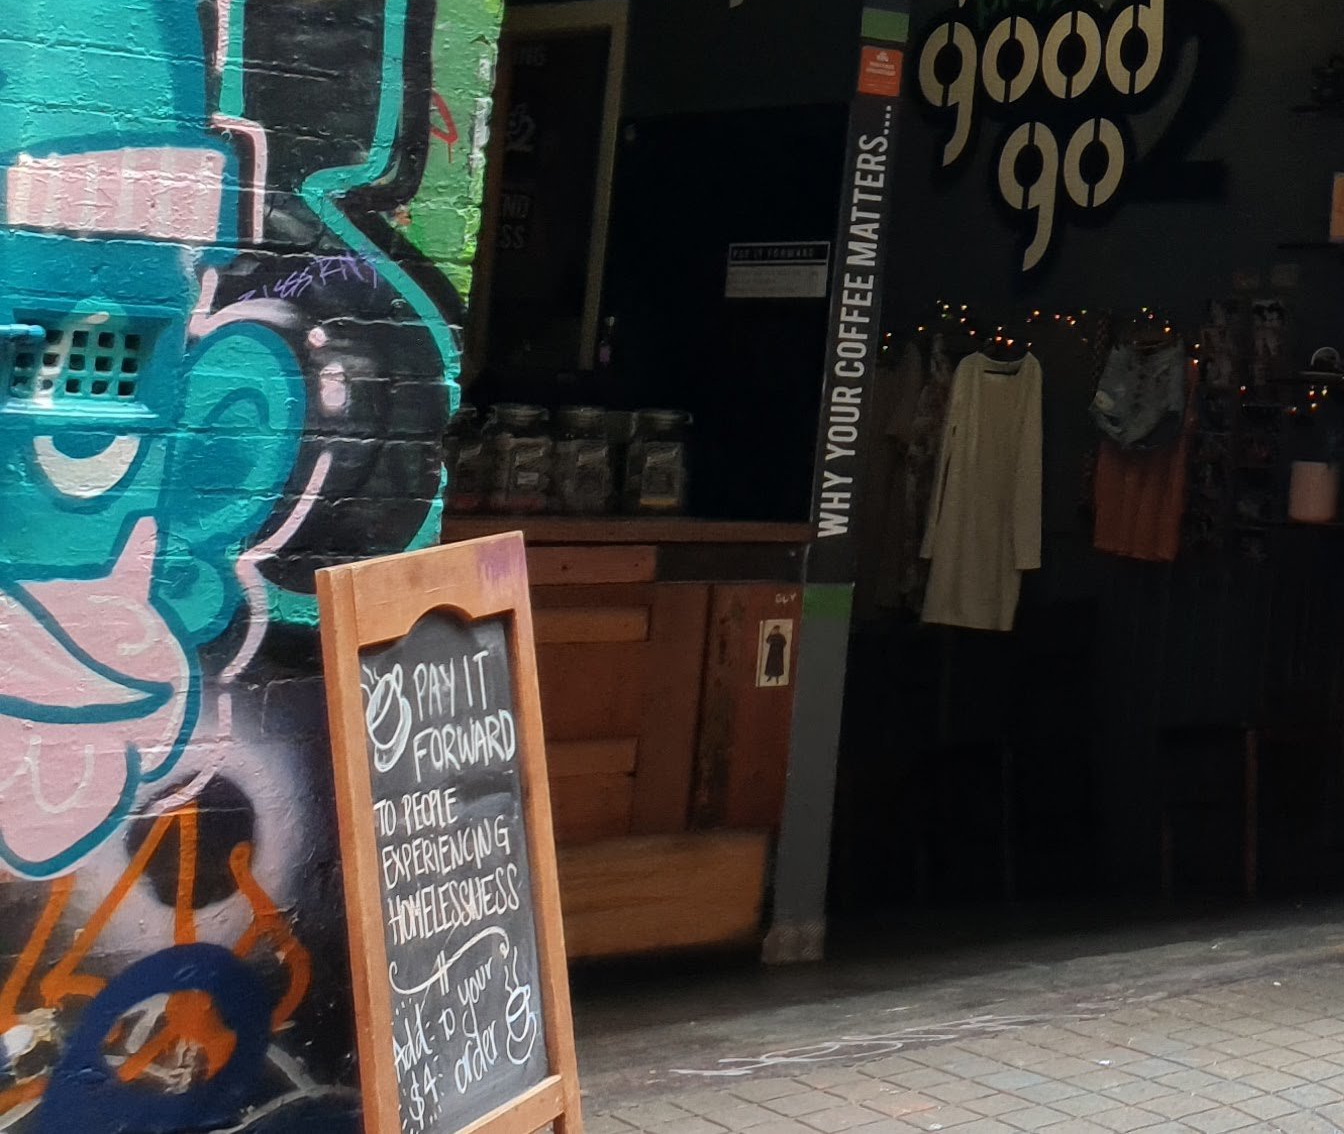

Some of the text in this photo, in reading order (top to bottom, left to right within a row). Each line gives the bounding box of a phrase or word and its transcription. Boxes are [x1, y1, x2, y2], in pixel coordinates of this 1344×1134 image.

[998, 117, 1125, 271] go
[836, 273, 876, 378] COFFEE
[825, 386, 864, 461] YOUR
[817, 470, 854, 538] WHY
[413, 650, 490, 722] PAY IT
[412, 708, 517, 784] FORWARD
[373, 787, 458, 837] TO PEOPLE
[387, 862, 521, 946] HOMELESSNESS
[392, 1003, 433, 1084] Add
[457, 957, 493, 1038] your
[455, 1020, 498, 1095] order
